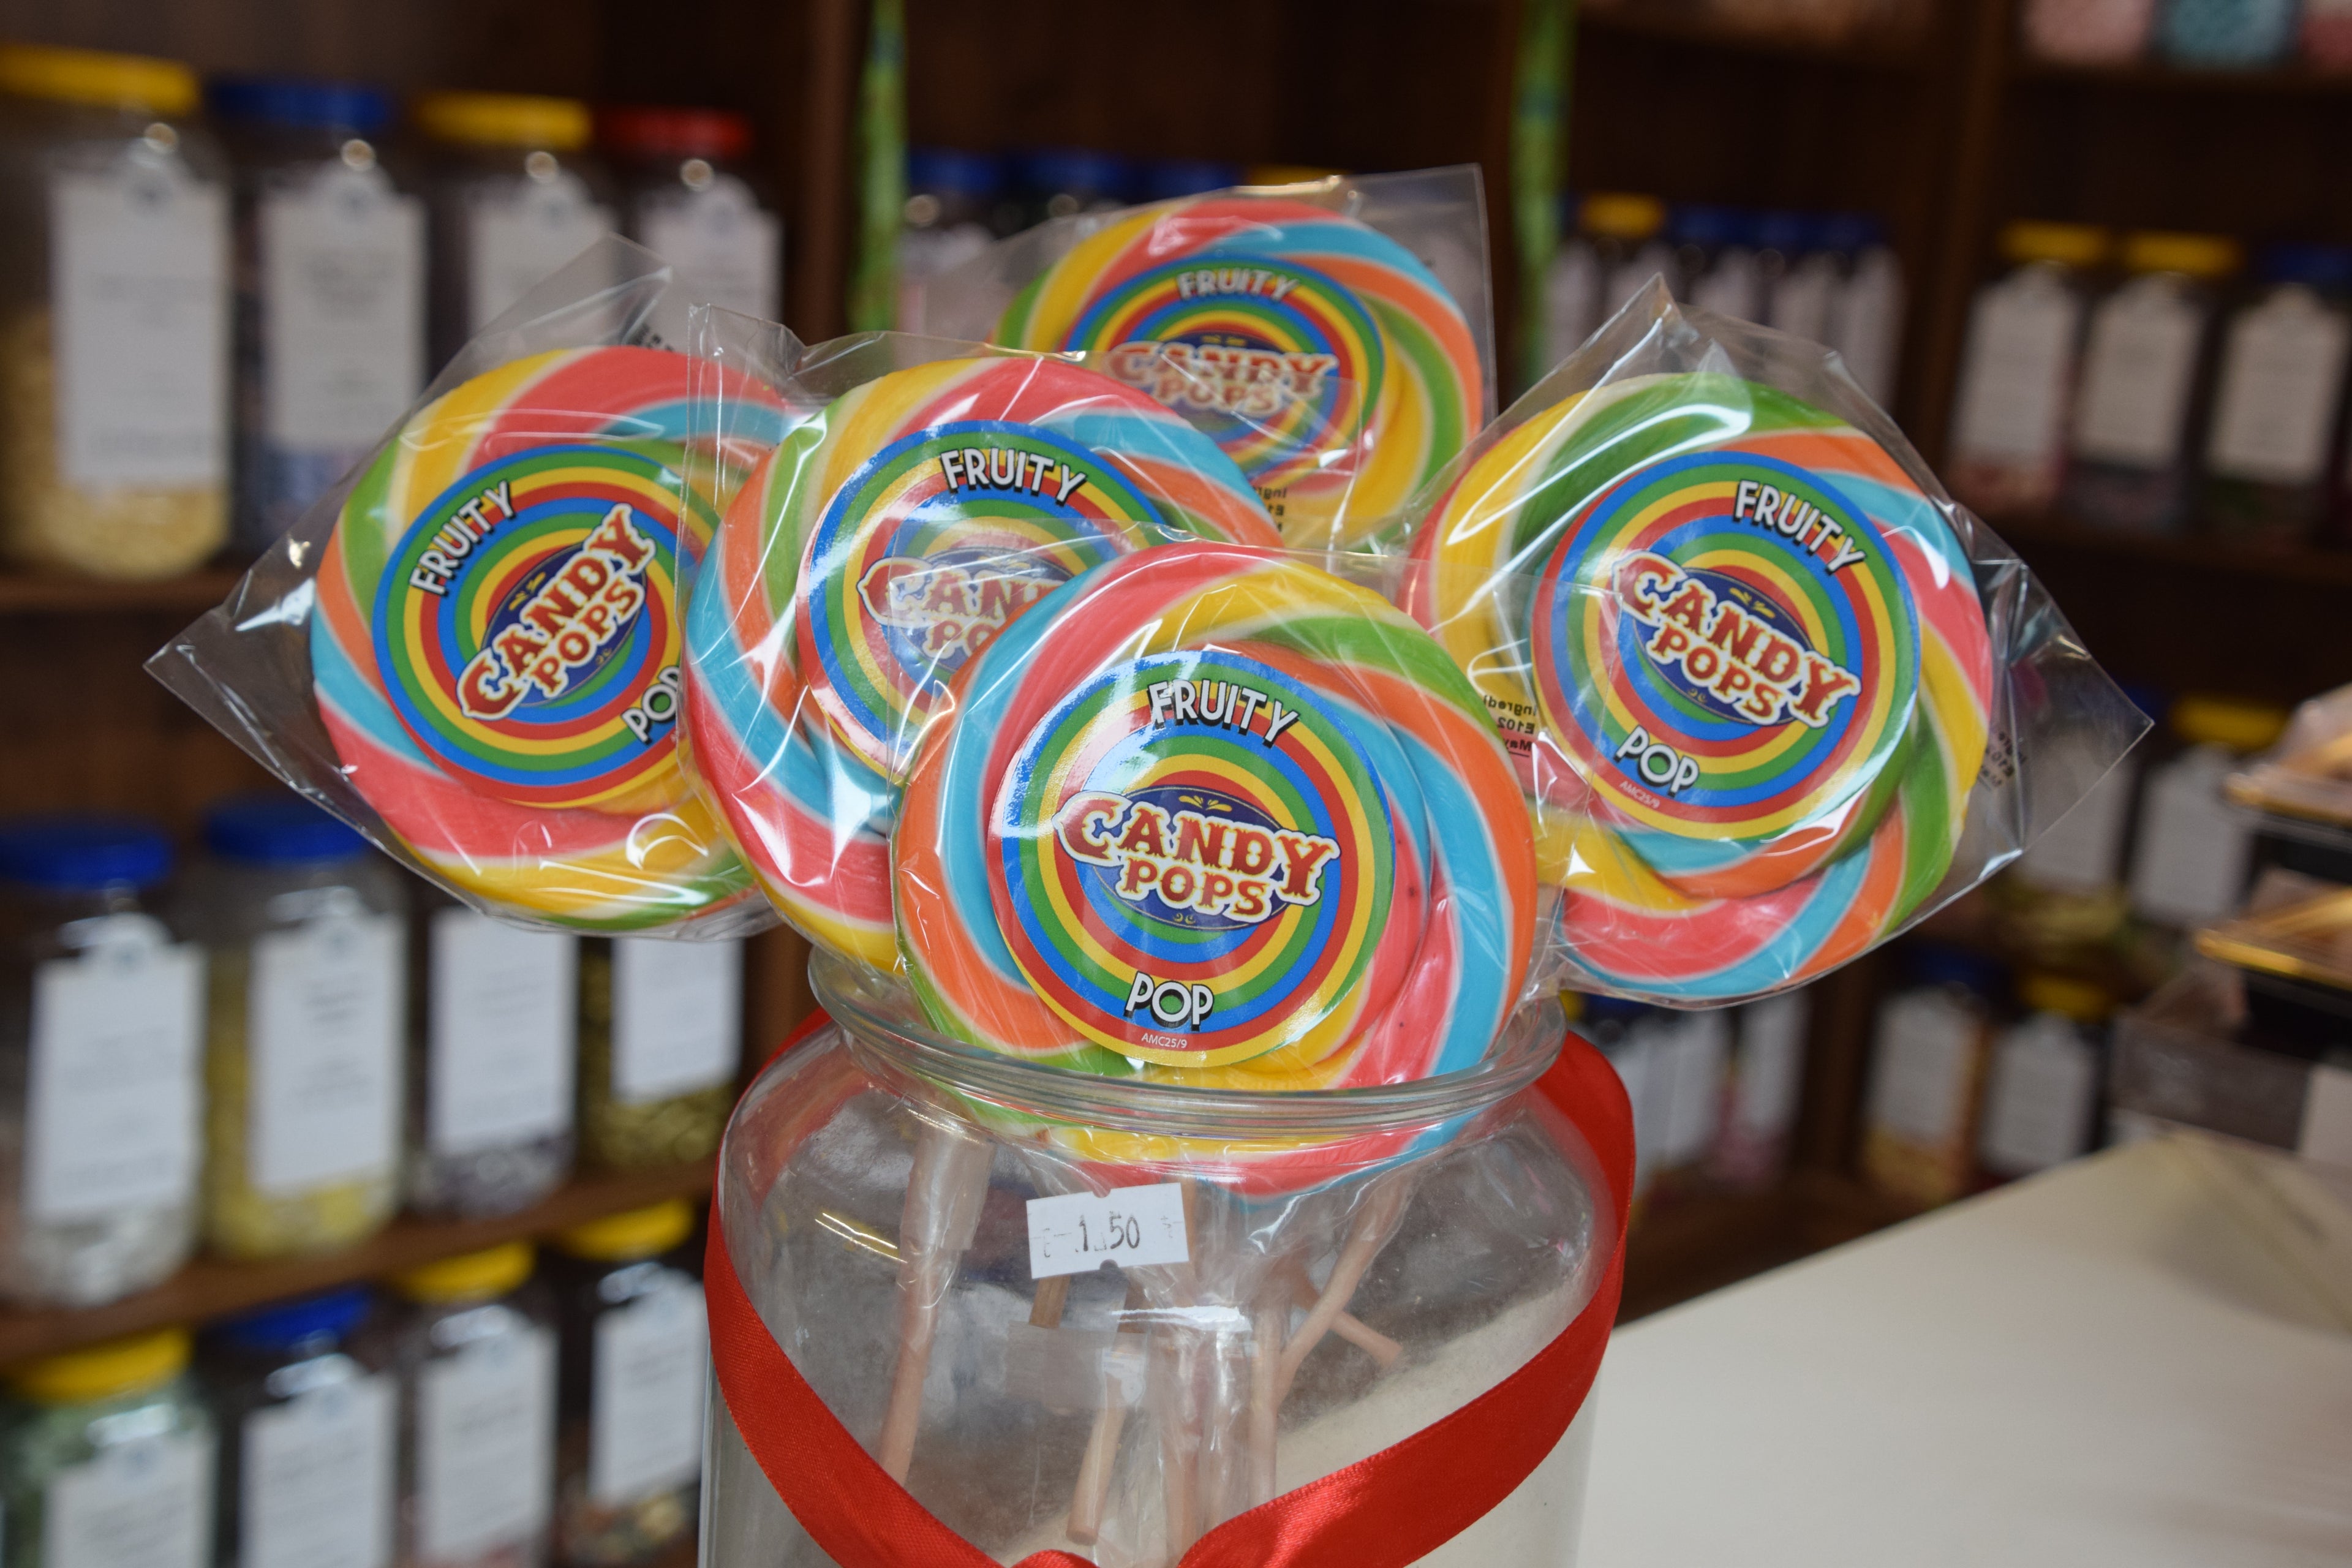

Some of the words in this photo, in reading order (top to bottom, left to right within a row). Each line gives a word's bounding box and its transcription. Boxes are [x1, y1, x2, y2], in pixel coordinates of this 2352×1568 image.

[1177, 268, 1300, 301] FRUITY
[1107, 341, 1339, 399] CANDY
[1155, 371, 1283, 419] POPS
[940, 448, 1088, 507] FRUITY
[410, 480, 516, 598] FRUITY
[1733, 480, 1866, 575] FRUITY
[457, 503, 656, 720] CANDY
[857, 557, 1065, 627] CAN
[530, 577, 646, 698] POPS
[1612, 549, 1861, 728] CANDY
[1646, 622, 1782, 726] POPS
[1148, 679, 1299, 748] FRUITY
[1614, 725, 1699, 797] POP
[1052, 790, 1341, 906] CANDY
[1117, 858, 1273, 922] POPS
[1123, 971, 1215, 1031] POP
[1141, 1033, 1187, 1048] AMC25/9
